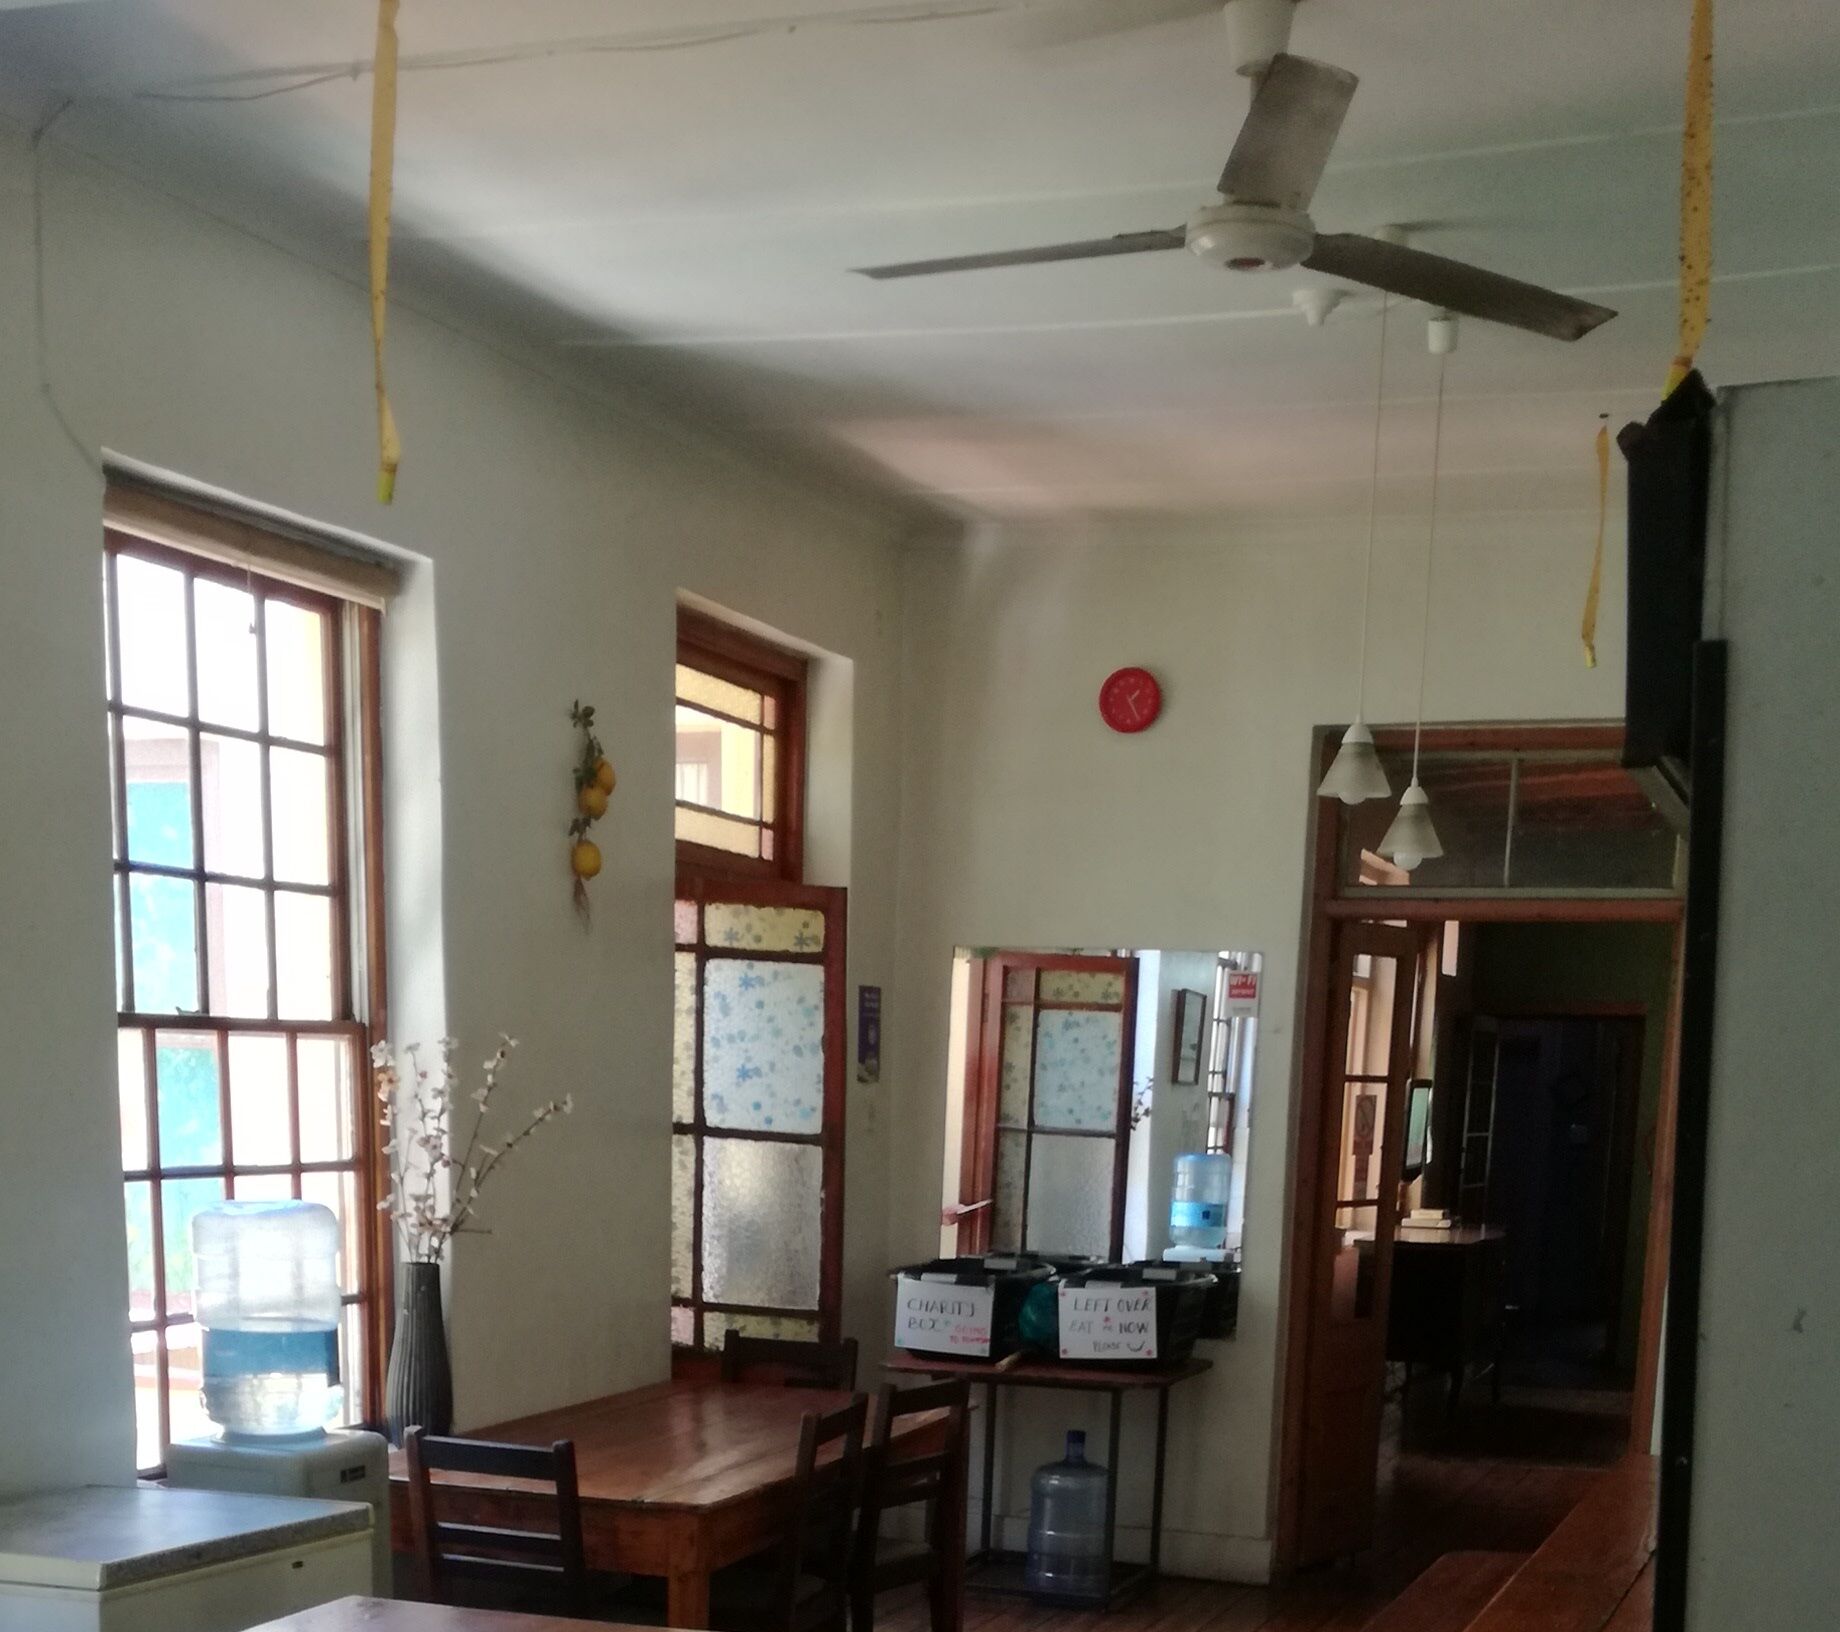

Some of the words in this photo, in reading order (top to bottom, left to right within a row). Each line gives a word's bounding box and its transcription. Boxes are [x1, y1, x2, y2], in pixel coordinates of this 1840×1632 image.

[906, 1298, 975, 1317] CHARITY
[1073, 1297, 1112, 1313] LEFT
[1116, 1298, 1152, 1313] OVER
[907, 1316, 943, 1332] BOX
[1119, 1321, 1149, 1334] NOW
